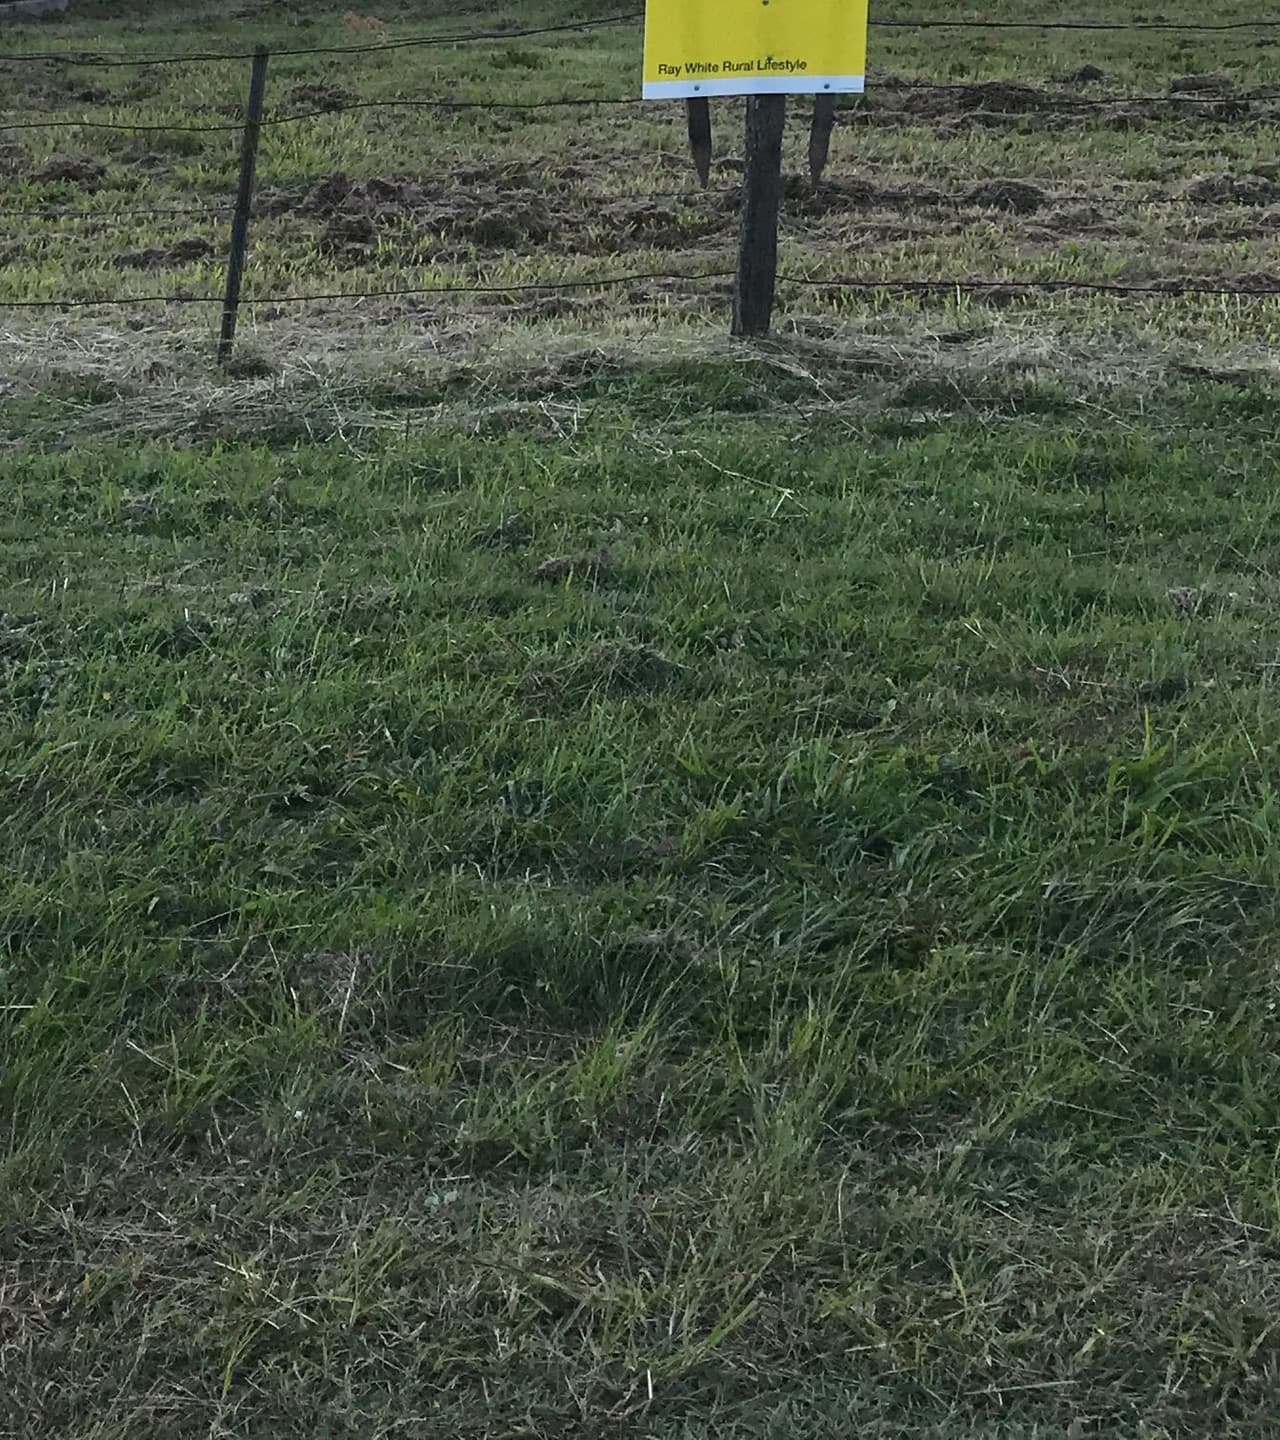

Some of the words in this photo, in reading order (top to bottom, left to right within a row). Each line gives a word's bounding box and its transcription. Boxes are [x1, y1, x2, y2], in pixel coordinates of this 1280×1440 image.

[658, 63, 681, 76] Ray
[686, 62, 719, 74] White
[723, 60, 754, 72] Rural
[757, 59, 807, 71] Lifestyle
